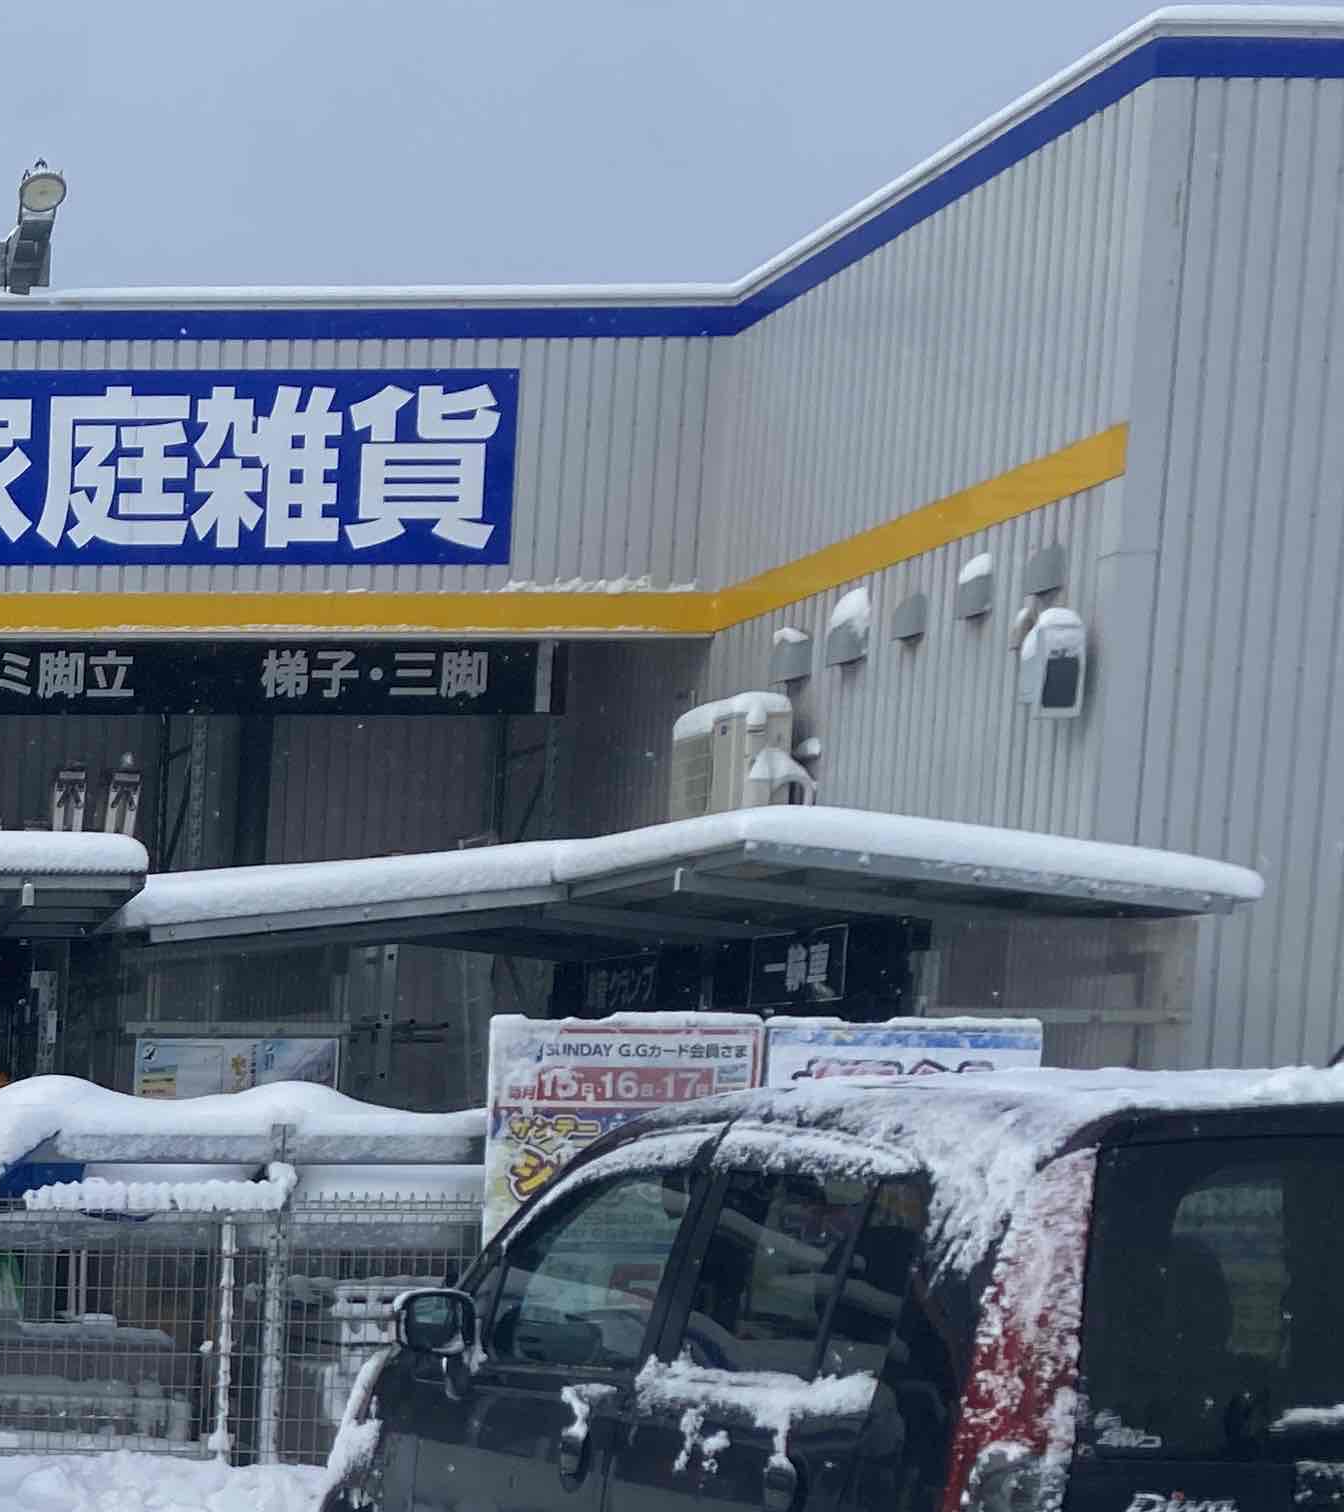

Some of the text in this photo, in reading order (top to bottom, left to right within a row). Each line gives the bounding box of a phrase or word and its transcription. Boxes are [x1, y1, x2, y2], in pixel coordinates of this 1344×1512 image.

[261, 648, 489, 699] 梯子・三脚
[545, 1043, 748, 1059] SUNDAY G.Gカード会員さま
